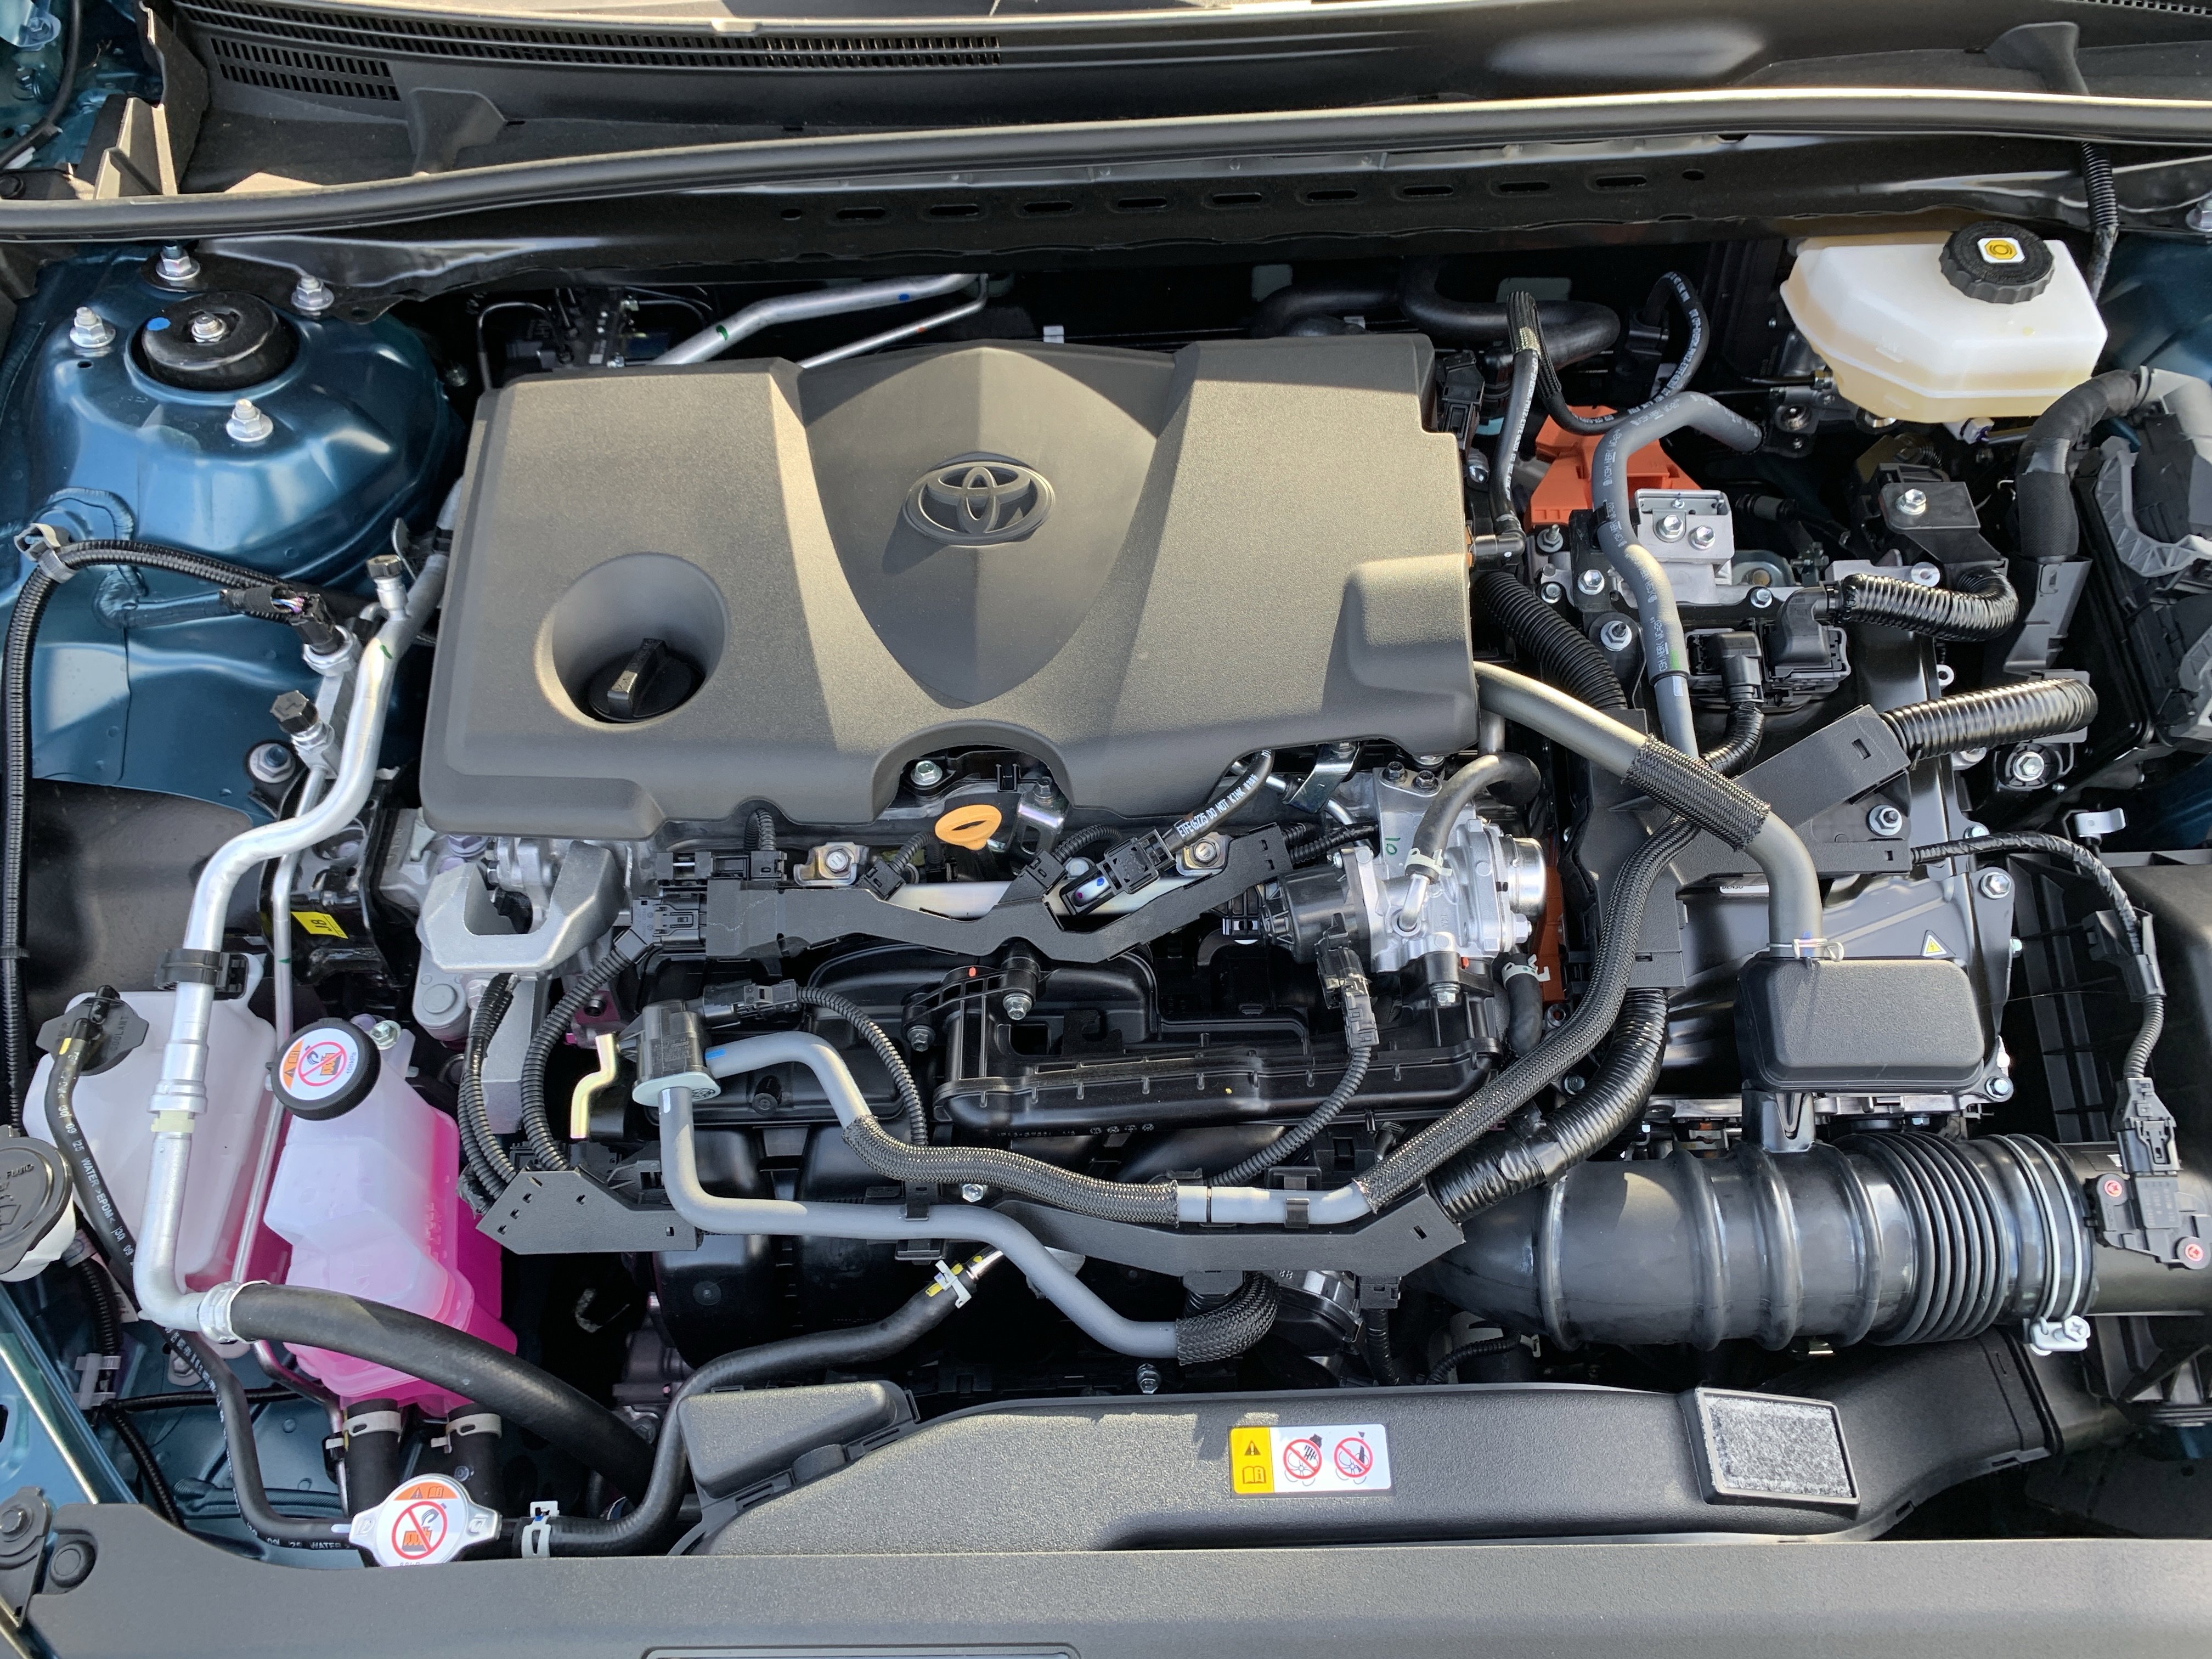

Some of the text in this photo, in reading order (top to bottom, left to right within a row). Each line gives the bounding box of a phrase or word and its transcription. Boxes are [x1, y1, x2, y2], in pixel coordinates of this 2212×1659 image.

[1205, 807, 1218, 820] DO
[1215, 798, 1229, 814] NOT
[1227, 787, 1246, 804] KINK
[346, 1052, 357, 1074] 108kPa
[81, 1157, 100, 1188] WATER
